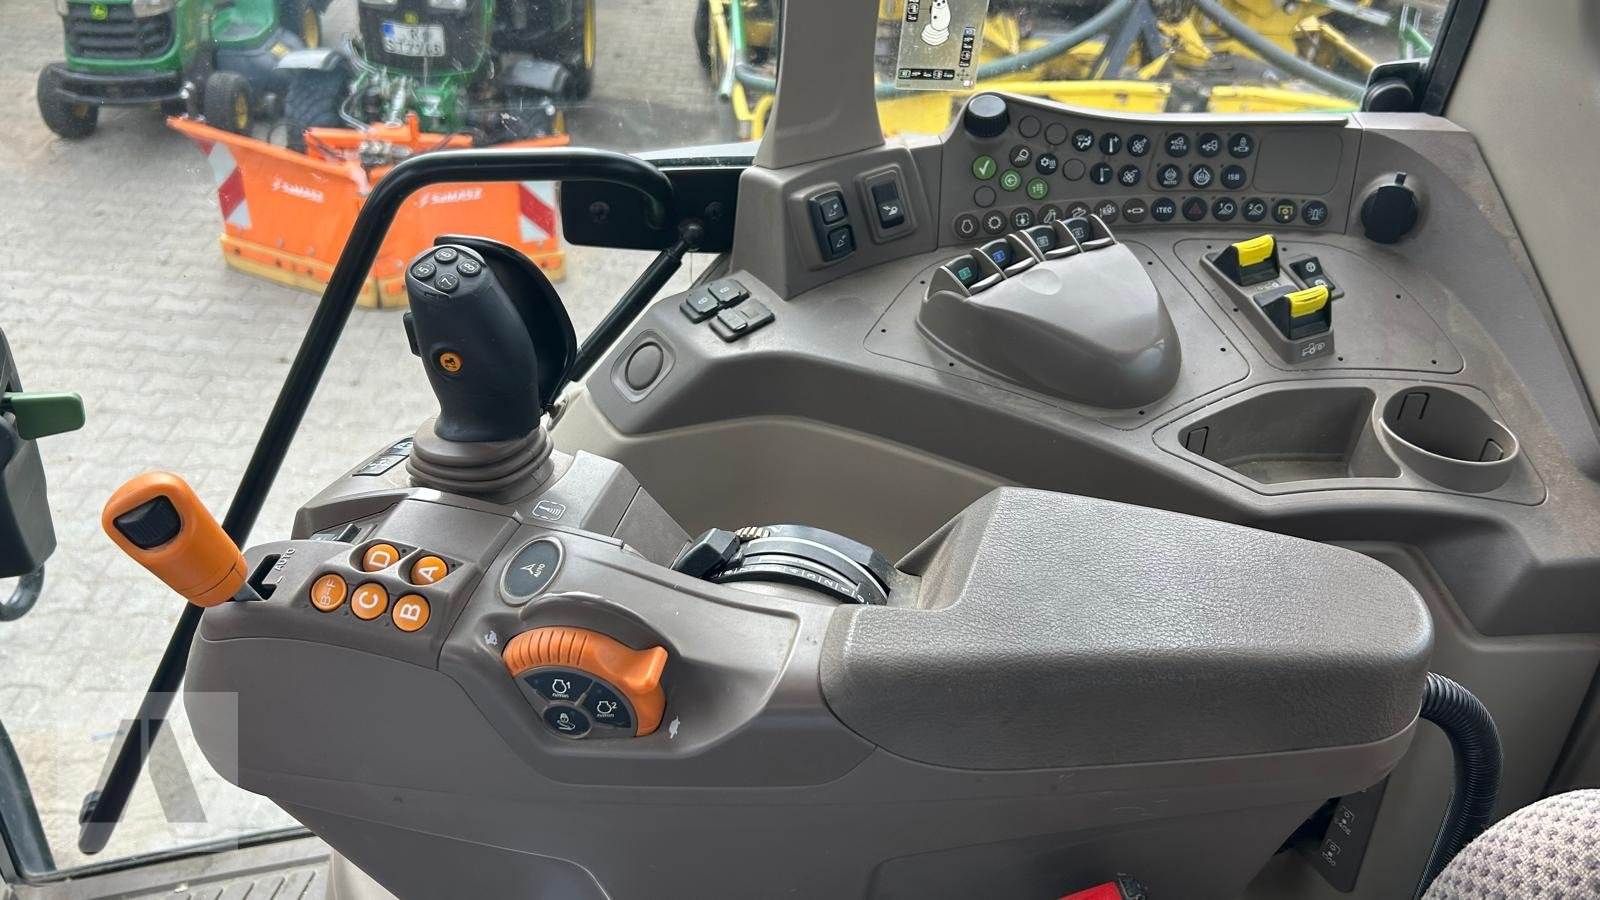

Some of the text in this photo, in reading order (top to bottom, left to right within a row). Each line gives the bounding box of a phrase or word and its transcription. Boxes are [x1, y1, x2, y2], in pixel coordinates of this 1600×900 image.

[464, 263, 475, 271] 8
[441, 277, 452, 286] 7
[274, 547, 296, 572] AUTO
[368, 550, 392, 569] D
[418, 566, 440, 583] A
[533, 563, 546, 578] AUTO
[358, 591, 379, 609] C
[399, 603, 421, 622] B
